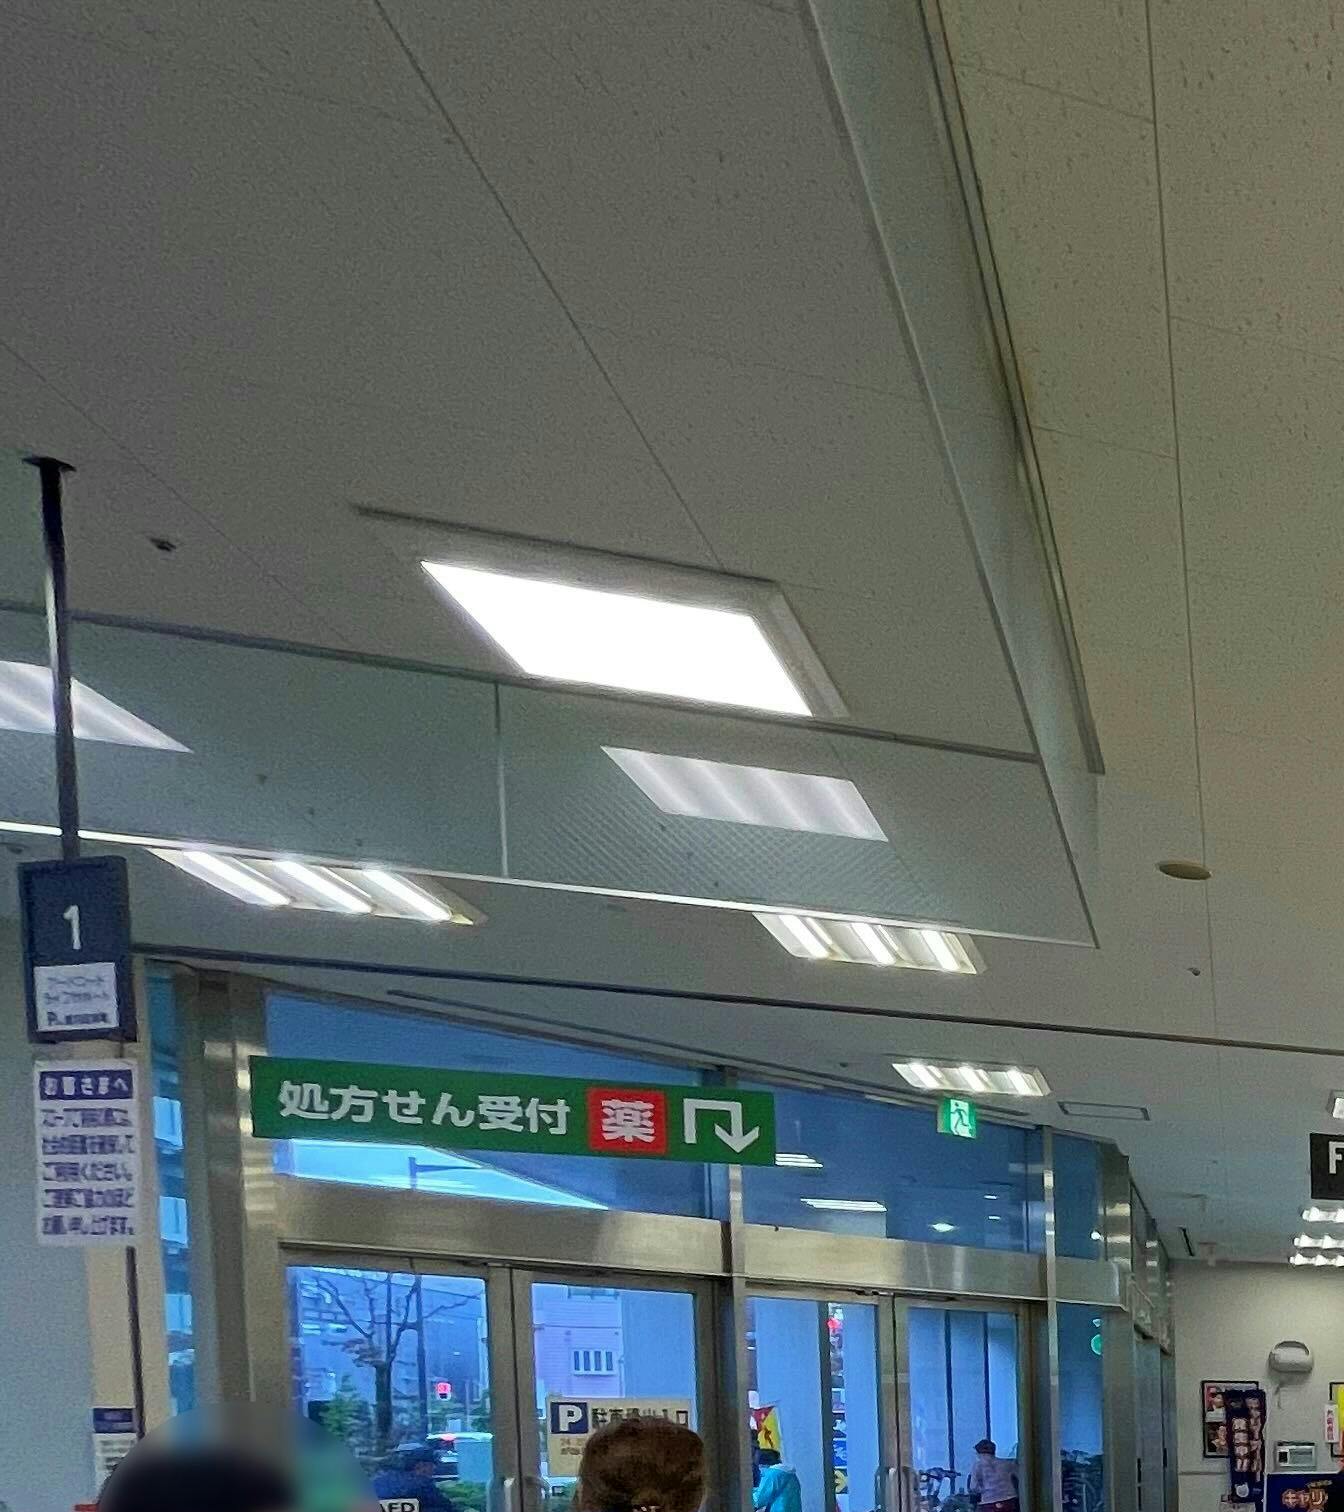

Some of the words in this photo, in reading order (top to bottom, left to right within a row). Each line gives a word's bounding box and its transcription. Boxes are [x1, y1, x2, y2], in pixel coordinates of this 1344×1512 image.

[64, 905, 81, 950] 1
[278, 1080, 571, 1136] 処方せん受付
[601, 1100, 655, 1144] 薬
[558, 1404, 583, 1431] P
